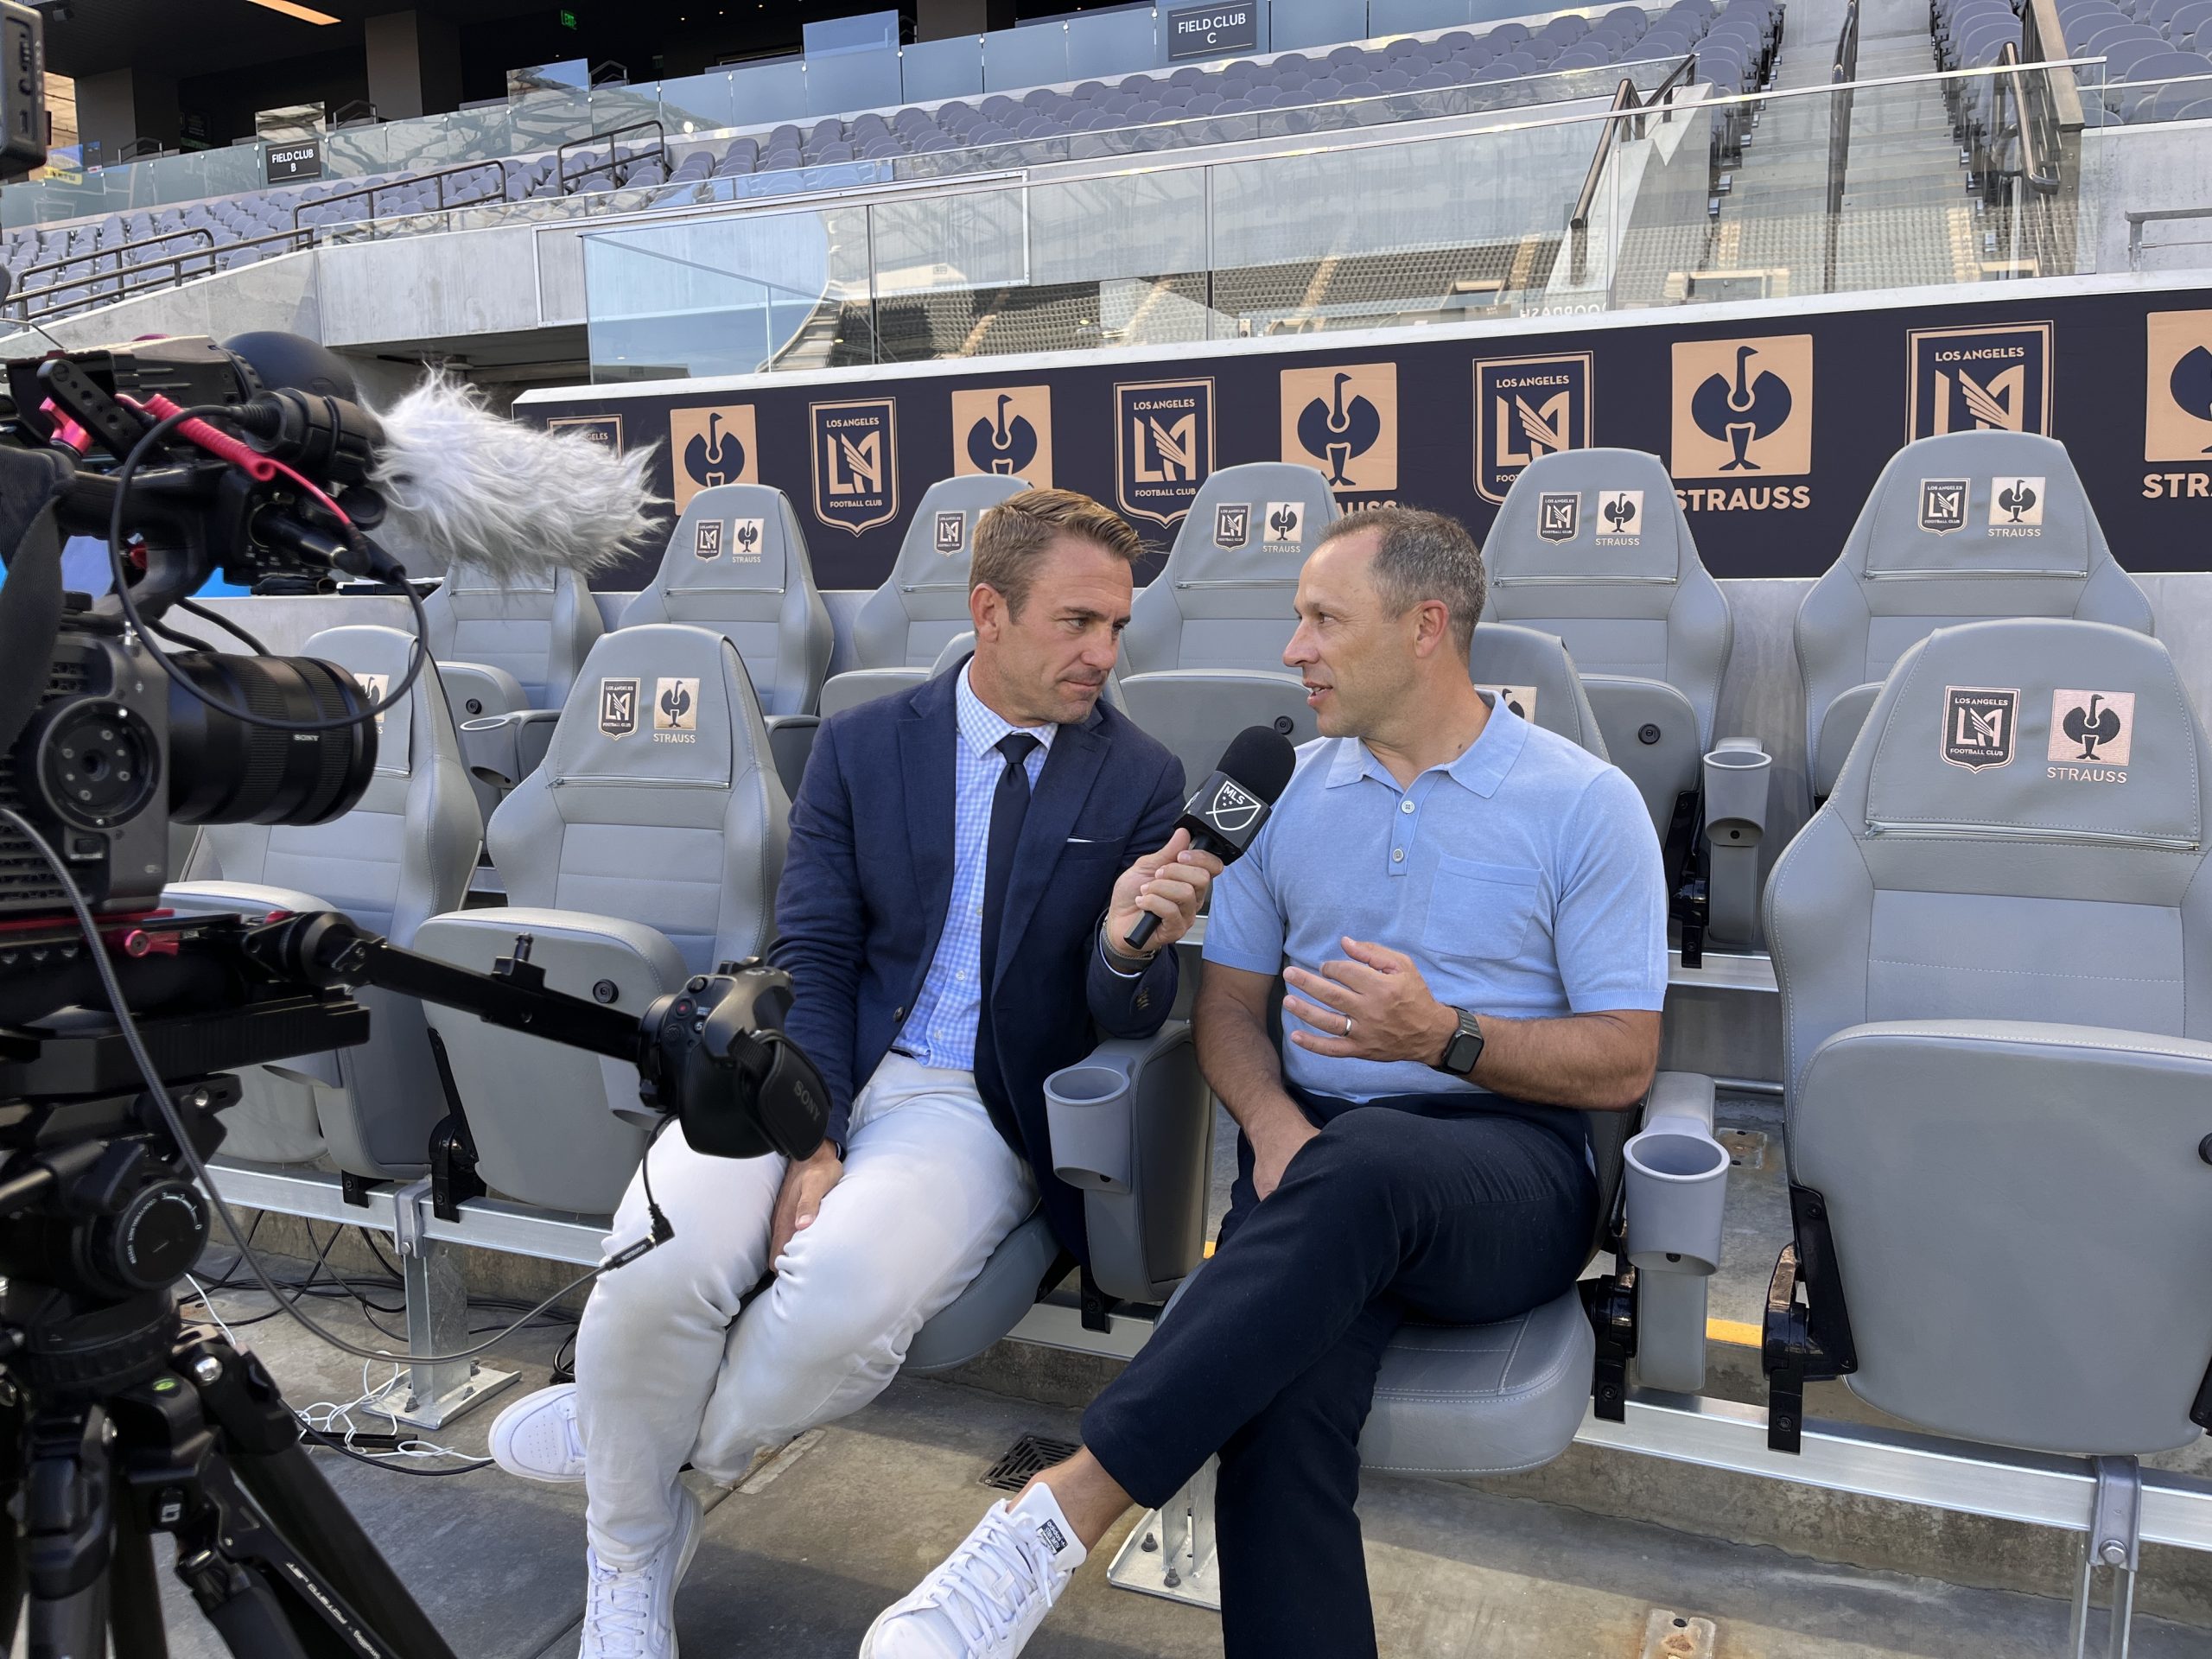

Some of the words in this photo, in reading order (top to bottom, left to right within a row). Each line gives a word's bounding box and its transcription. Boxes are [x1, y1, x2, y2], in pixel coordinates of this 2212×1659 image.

[1178, 18, 1211, 35] FIELD
[1213, 12, 1246, 28] CLUB
[1207, 32, 1217, 44] C
[271, 151, 293, 163] FIELD
[294, 149, 314, 161] CLUB
[290, 162, 296, 173] B
[1936, 351, 1961, 361] LOS
[1963, 347, 2024, 359] ANGELES
[1497, 378, 1517, 388] LOS
[1519, 375, 1569, 387] ANGELES
[1134, 401, 1151, 410] LOS
[1153, 399, 1195, 410] ANGELES
[826, 419, 842, 428] LOS
[843, 416, 880, 427] ANGELES
[1135, 488, 1174, 497] FOOTBALL
[1176, 487, 1196, 496] CLUB
[2142, 473, 2212, 499] STR
[1675, 486, 1810, 512] STRAUSS
[1988, 528, 2041, 537] STRAUSS
[1595, 537, 1640, 546] STRAUSS
[653, 734, 696, 743] STRAUSS
[2046, 766, 2127, 784] STRAUSS
[1224, 785, 1245, 805] MLS
[794, 1079, 821, 1122] SONY
